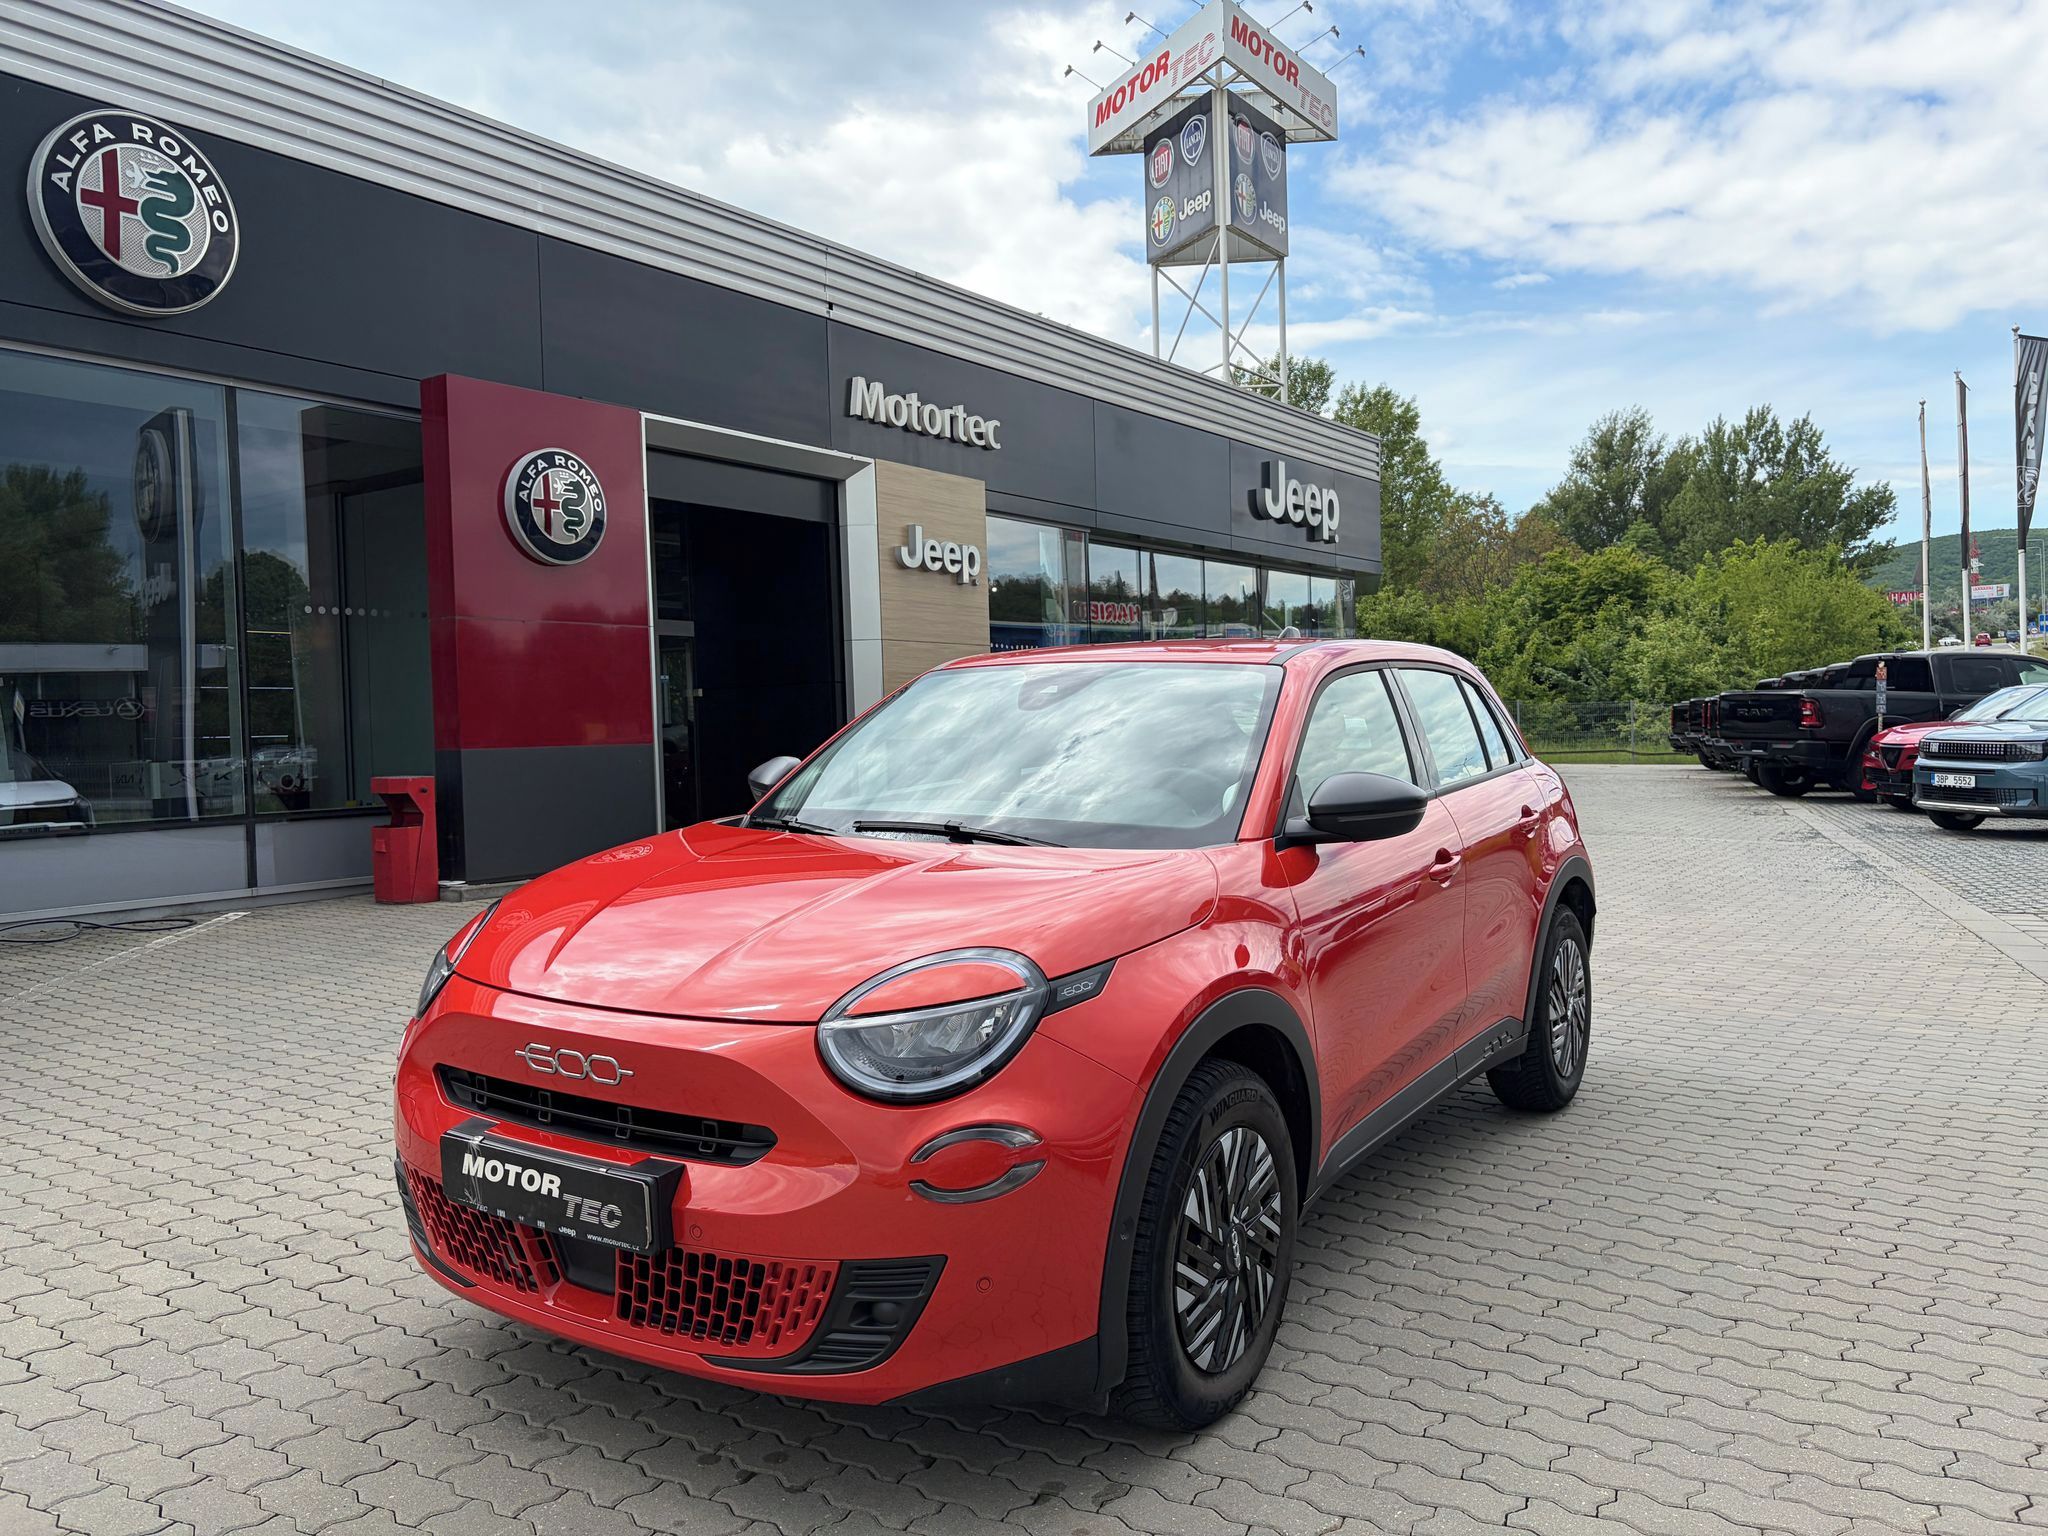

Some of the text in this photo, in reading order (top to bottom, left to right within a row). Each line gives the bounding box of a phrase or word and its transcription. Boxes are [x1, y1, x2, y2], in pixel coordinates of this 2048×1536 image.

[1095, 32, 1216, 128] MOTOR TEC
[1231, 14, 1333, 128] MOTOR TEC
[51, 122, 229, 234] ALFA ROMEO
[1154, 149, 1169, 178] FIAT
[1179, 190, 1211, 220] Jeep
[1259, 201, 1286, 234] Jeep
[849, 376, 1002, 450] Motortec
[2020, 371, 2038, 460] RAM
[518, 455, 604, 513] ALFA ROMEO
[1257, 460, 1339, 543] Jeep
[896, 524, 981, 585] Jeep
[1934, 773, 1973, 786] 3BP 5552
[1062, 981, 1093, 996] 600
[520, 1043, 628, 1086] 600
[1208, 1087, 1258, 1127] WINGUARD
[461, 1152, 623, 1229] MOTOR TEC
[558, 1225, 577, 1238] Jeep
